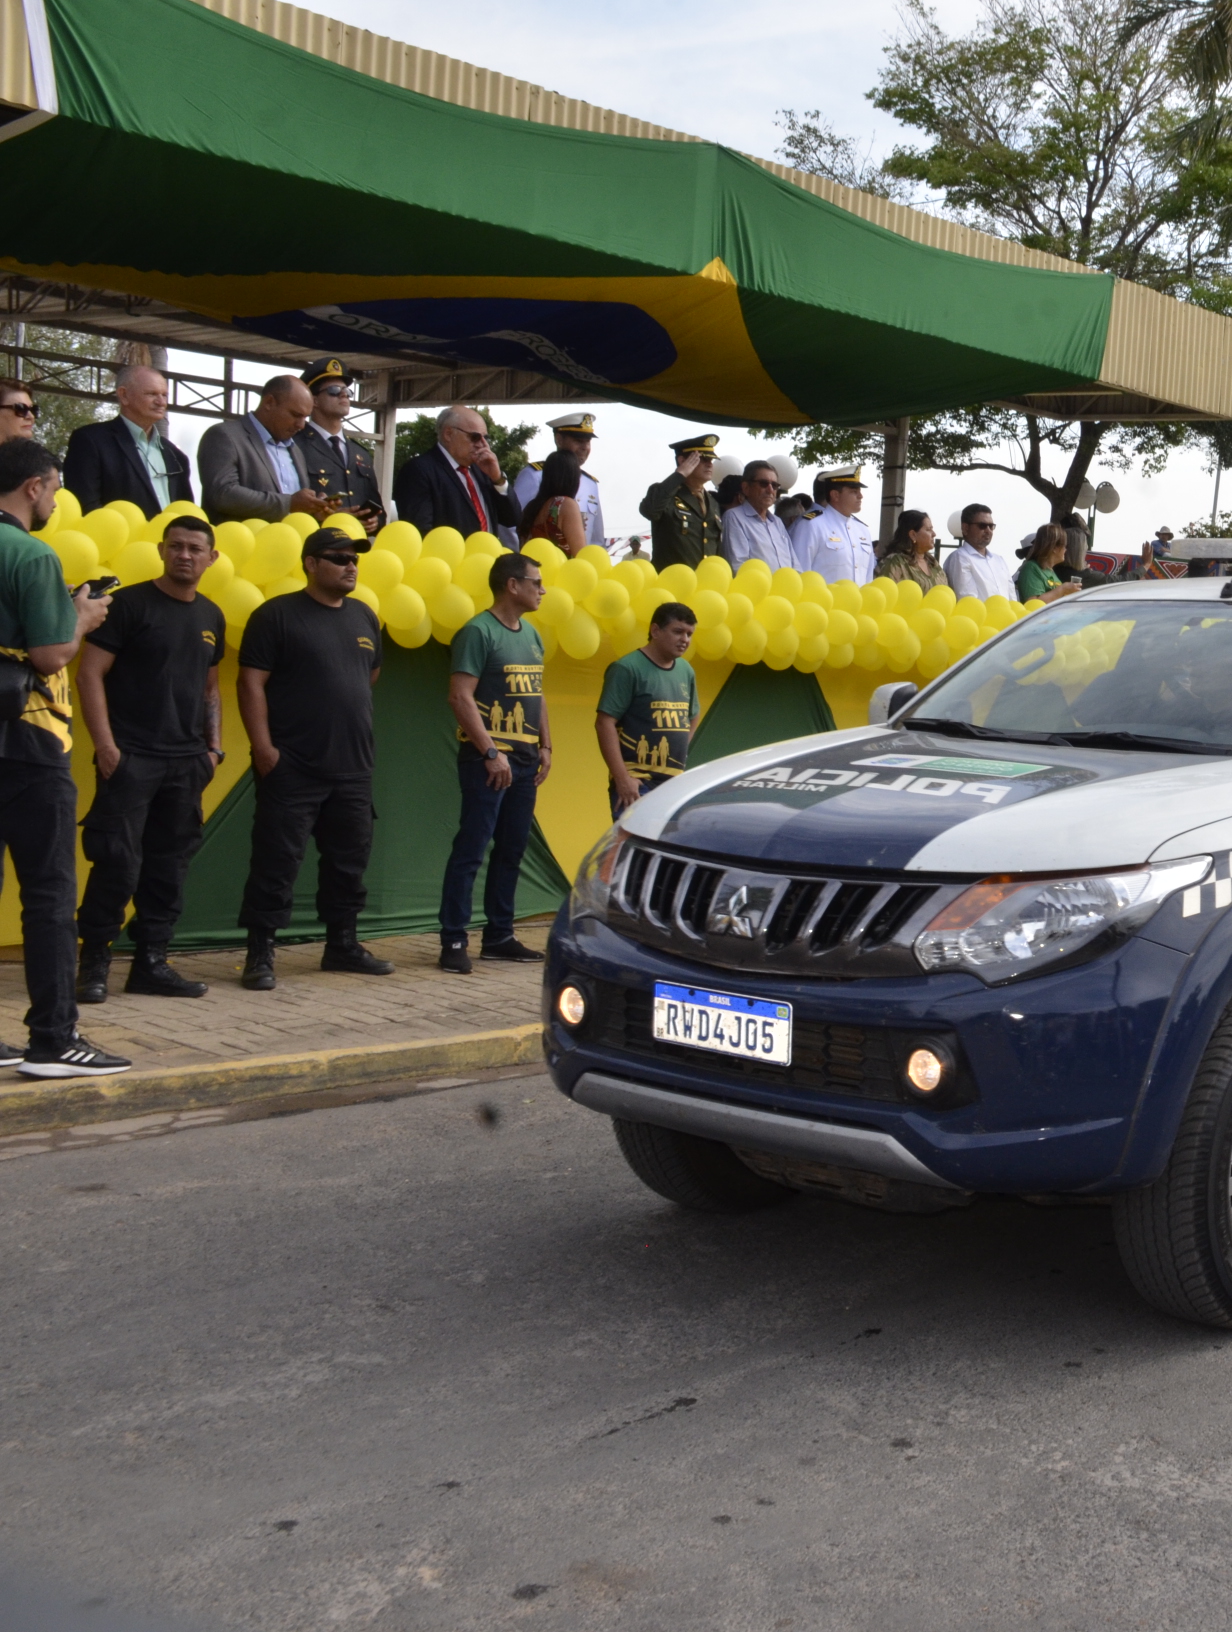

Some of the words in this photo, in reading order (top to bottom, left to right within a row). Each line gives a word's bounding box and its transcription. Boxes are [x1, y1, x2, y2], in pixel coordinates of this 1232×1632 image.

[506, 674, 533, 693] 111
[652, 710, 680, 728] 111
[709, 994, 731, 1006] BRASIL
[666, 1003, 774, 1053] RWD4J05
